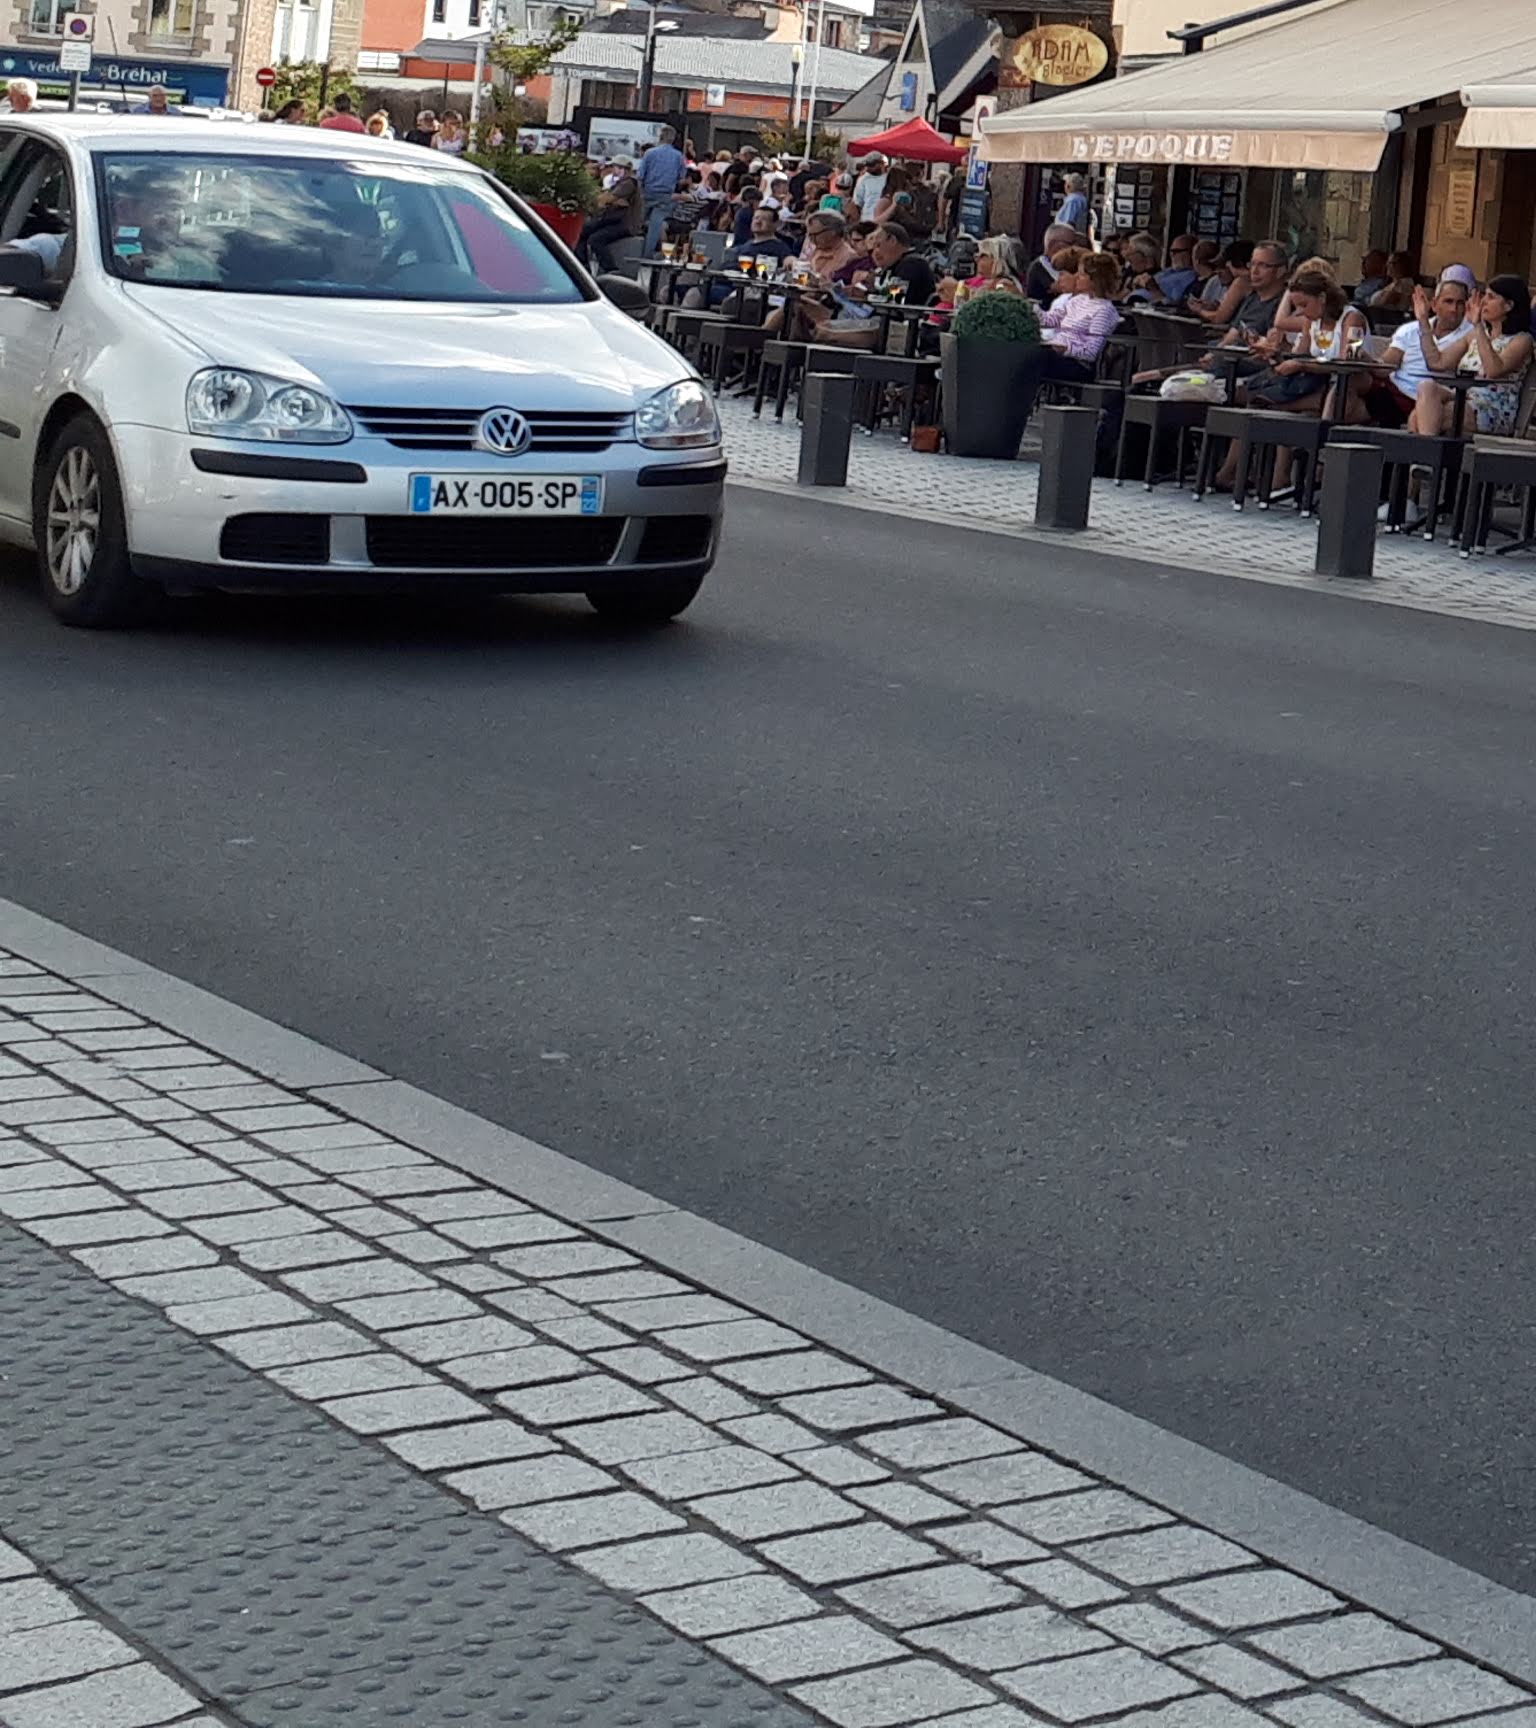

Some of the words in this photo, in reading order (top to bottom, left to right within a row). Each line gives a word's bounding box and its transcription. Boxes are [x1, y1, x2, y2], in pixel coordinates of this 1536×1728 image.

[107, 64, 167, 84] Bréhat
[1071, 133, 1234, 161] L'EPOQUE
[432, 480, 578, 509] AX-005-SP
